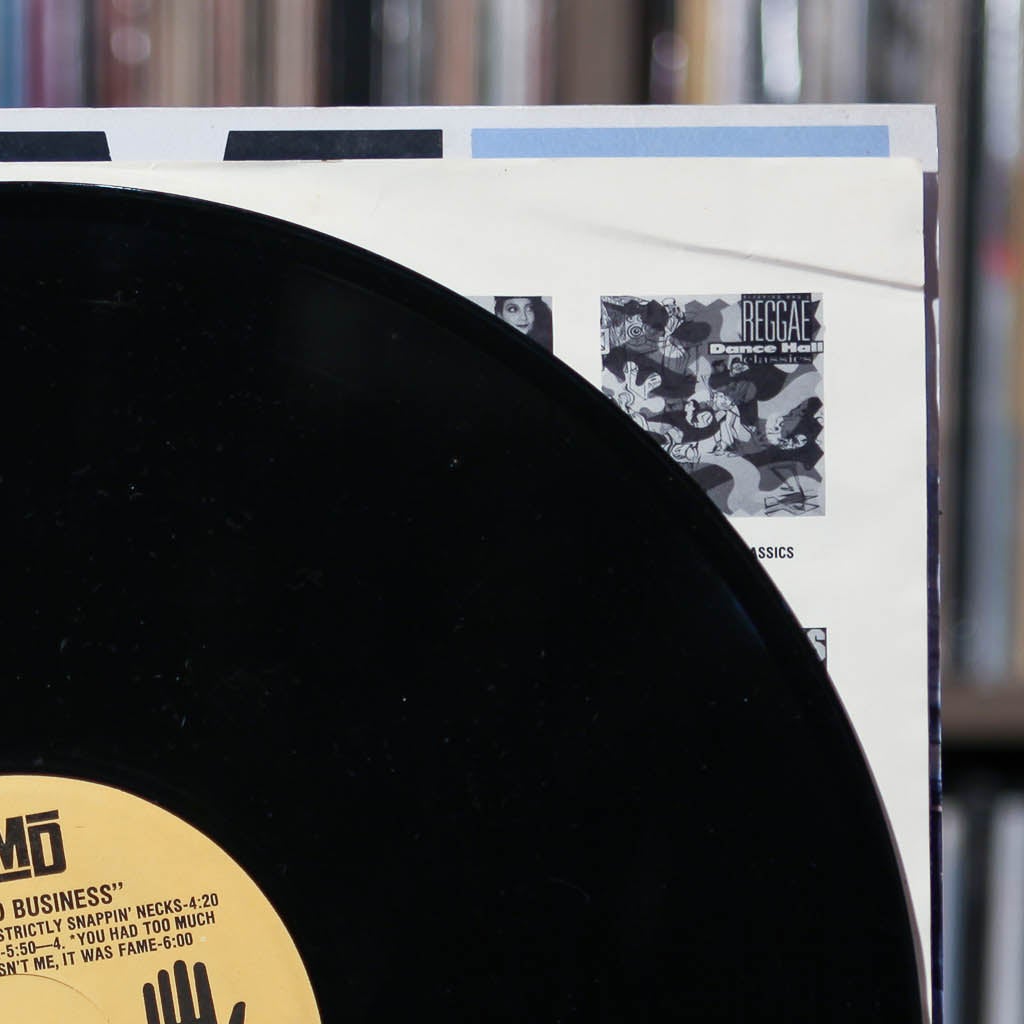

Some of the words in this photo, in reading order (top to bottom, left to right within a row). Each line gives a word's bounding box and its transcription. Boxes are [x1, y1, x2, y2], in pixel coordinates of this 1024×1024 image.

[743, 300, 811, 342] REGGAE
[709, 343, 778, 355] Dance
[780, 342, 824, 354] Hall
[135, 892, 218, 919] NECKS-4:20
[108, 923, 138, 941] HAD
[141, 917, 170, 935] TOO
[173, 910, 215, 930] MUCH
[32, 954, 59, 971] ME,
[61, 950, 75, 966] IT
[79, 944, 113, 963] WAS
[117, 931, 193, 957] FAME-6:00
